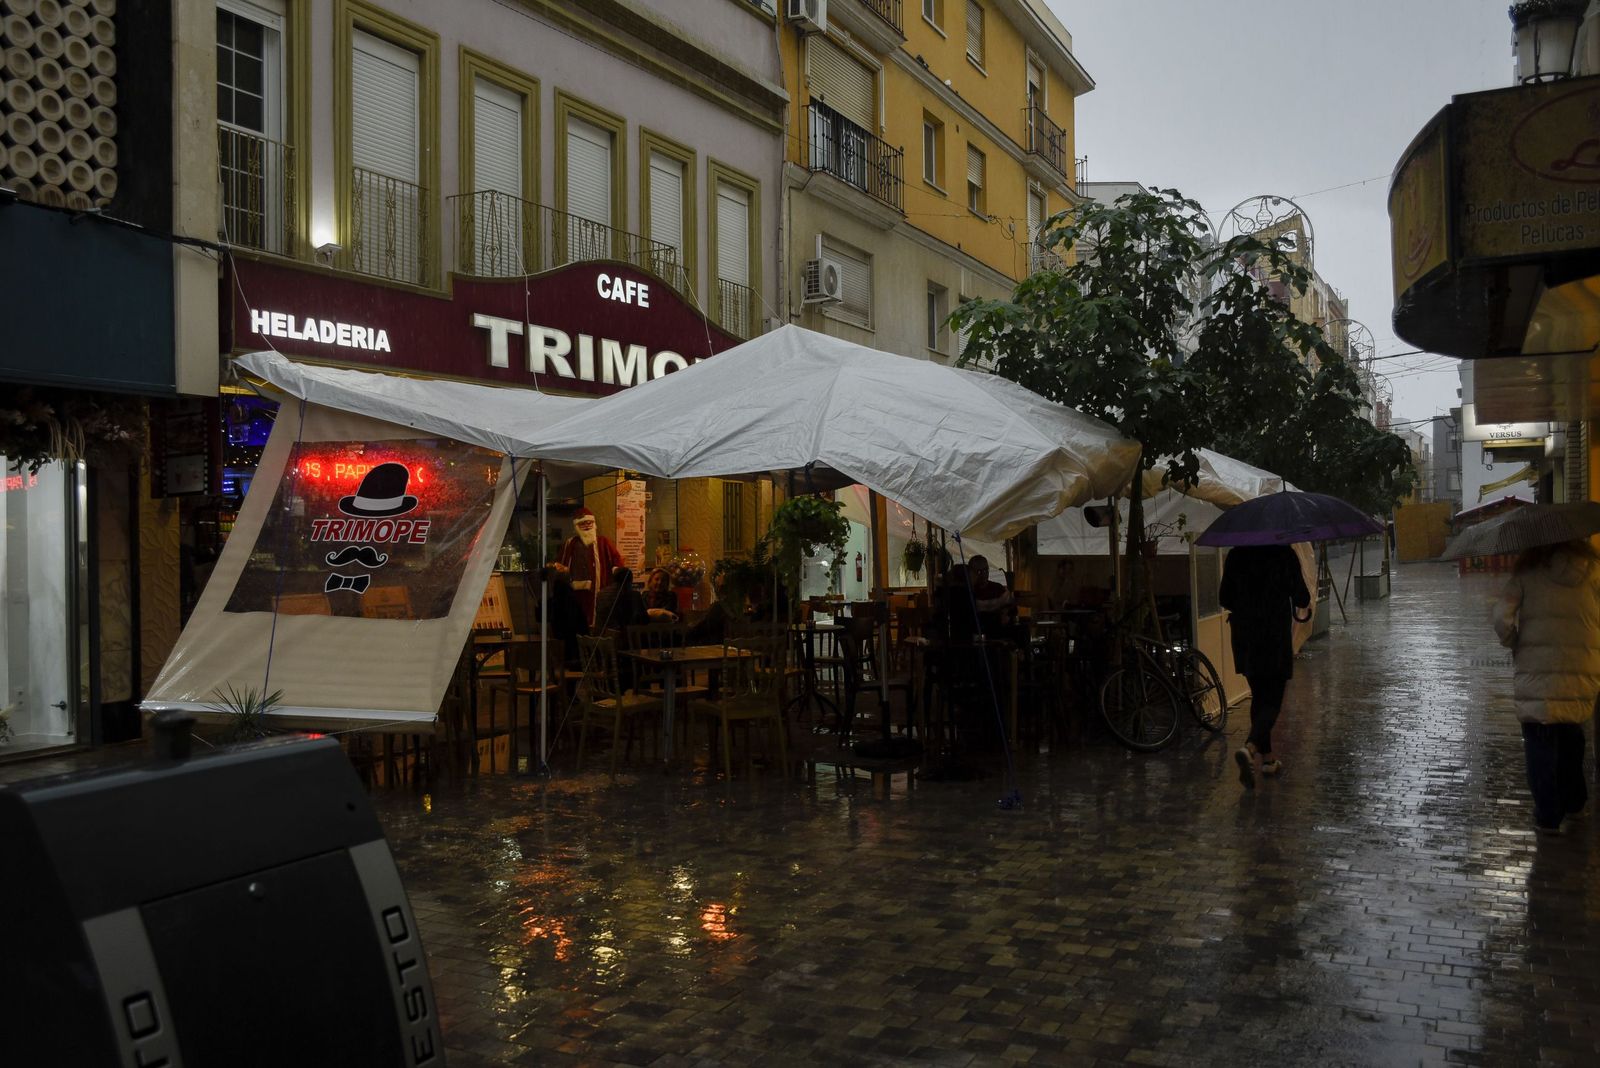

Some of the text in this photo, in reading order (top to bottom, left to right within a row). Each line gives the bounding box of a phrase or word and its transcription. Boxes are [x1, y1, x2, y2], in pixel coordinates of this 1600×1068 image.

[1465, 200, 1545, 224] Productos
[1551, 192, 1571, 215] de
[1521, 223, 1584, 245] Pelucas
[597, 273, 650, 309] CAFE
[251, 309, 391, 352] HELADERIA
[470, 312, 710, 387] TRIMO
[1489, 431, 1522, 439] VERSUS
[311, 519, 432, 545] TRIMOPE
